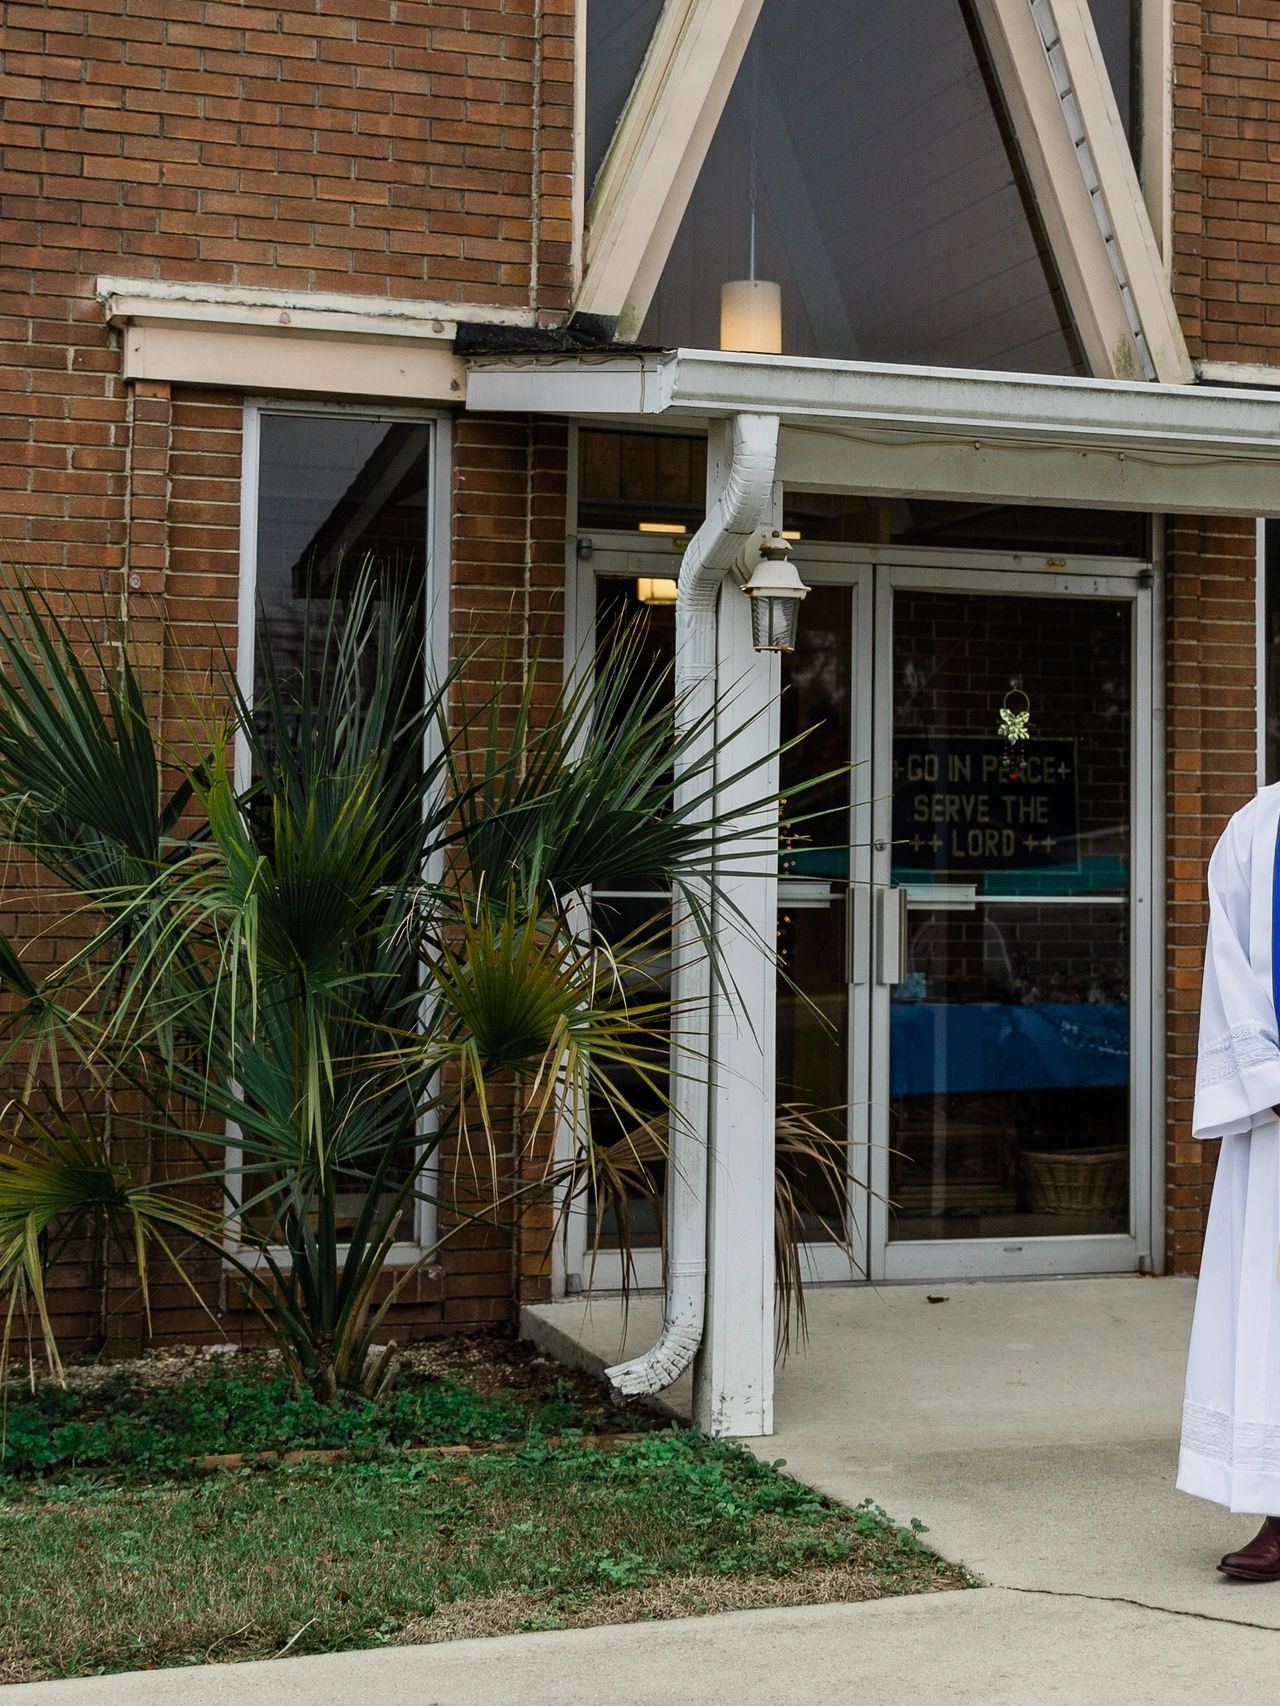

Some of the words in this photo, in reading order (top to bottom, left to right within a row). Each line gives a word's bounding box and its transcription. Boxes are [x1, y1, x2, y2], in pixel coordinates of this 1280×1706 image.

[907, 754, 939, 782] GO
[947, 754, 971, 782] IN
[913, 794, 990, 822] SERVE
[1000, 795, 1049, 823] THE
[952, 829, 1015, 857] LORD
